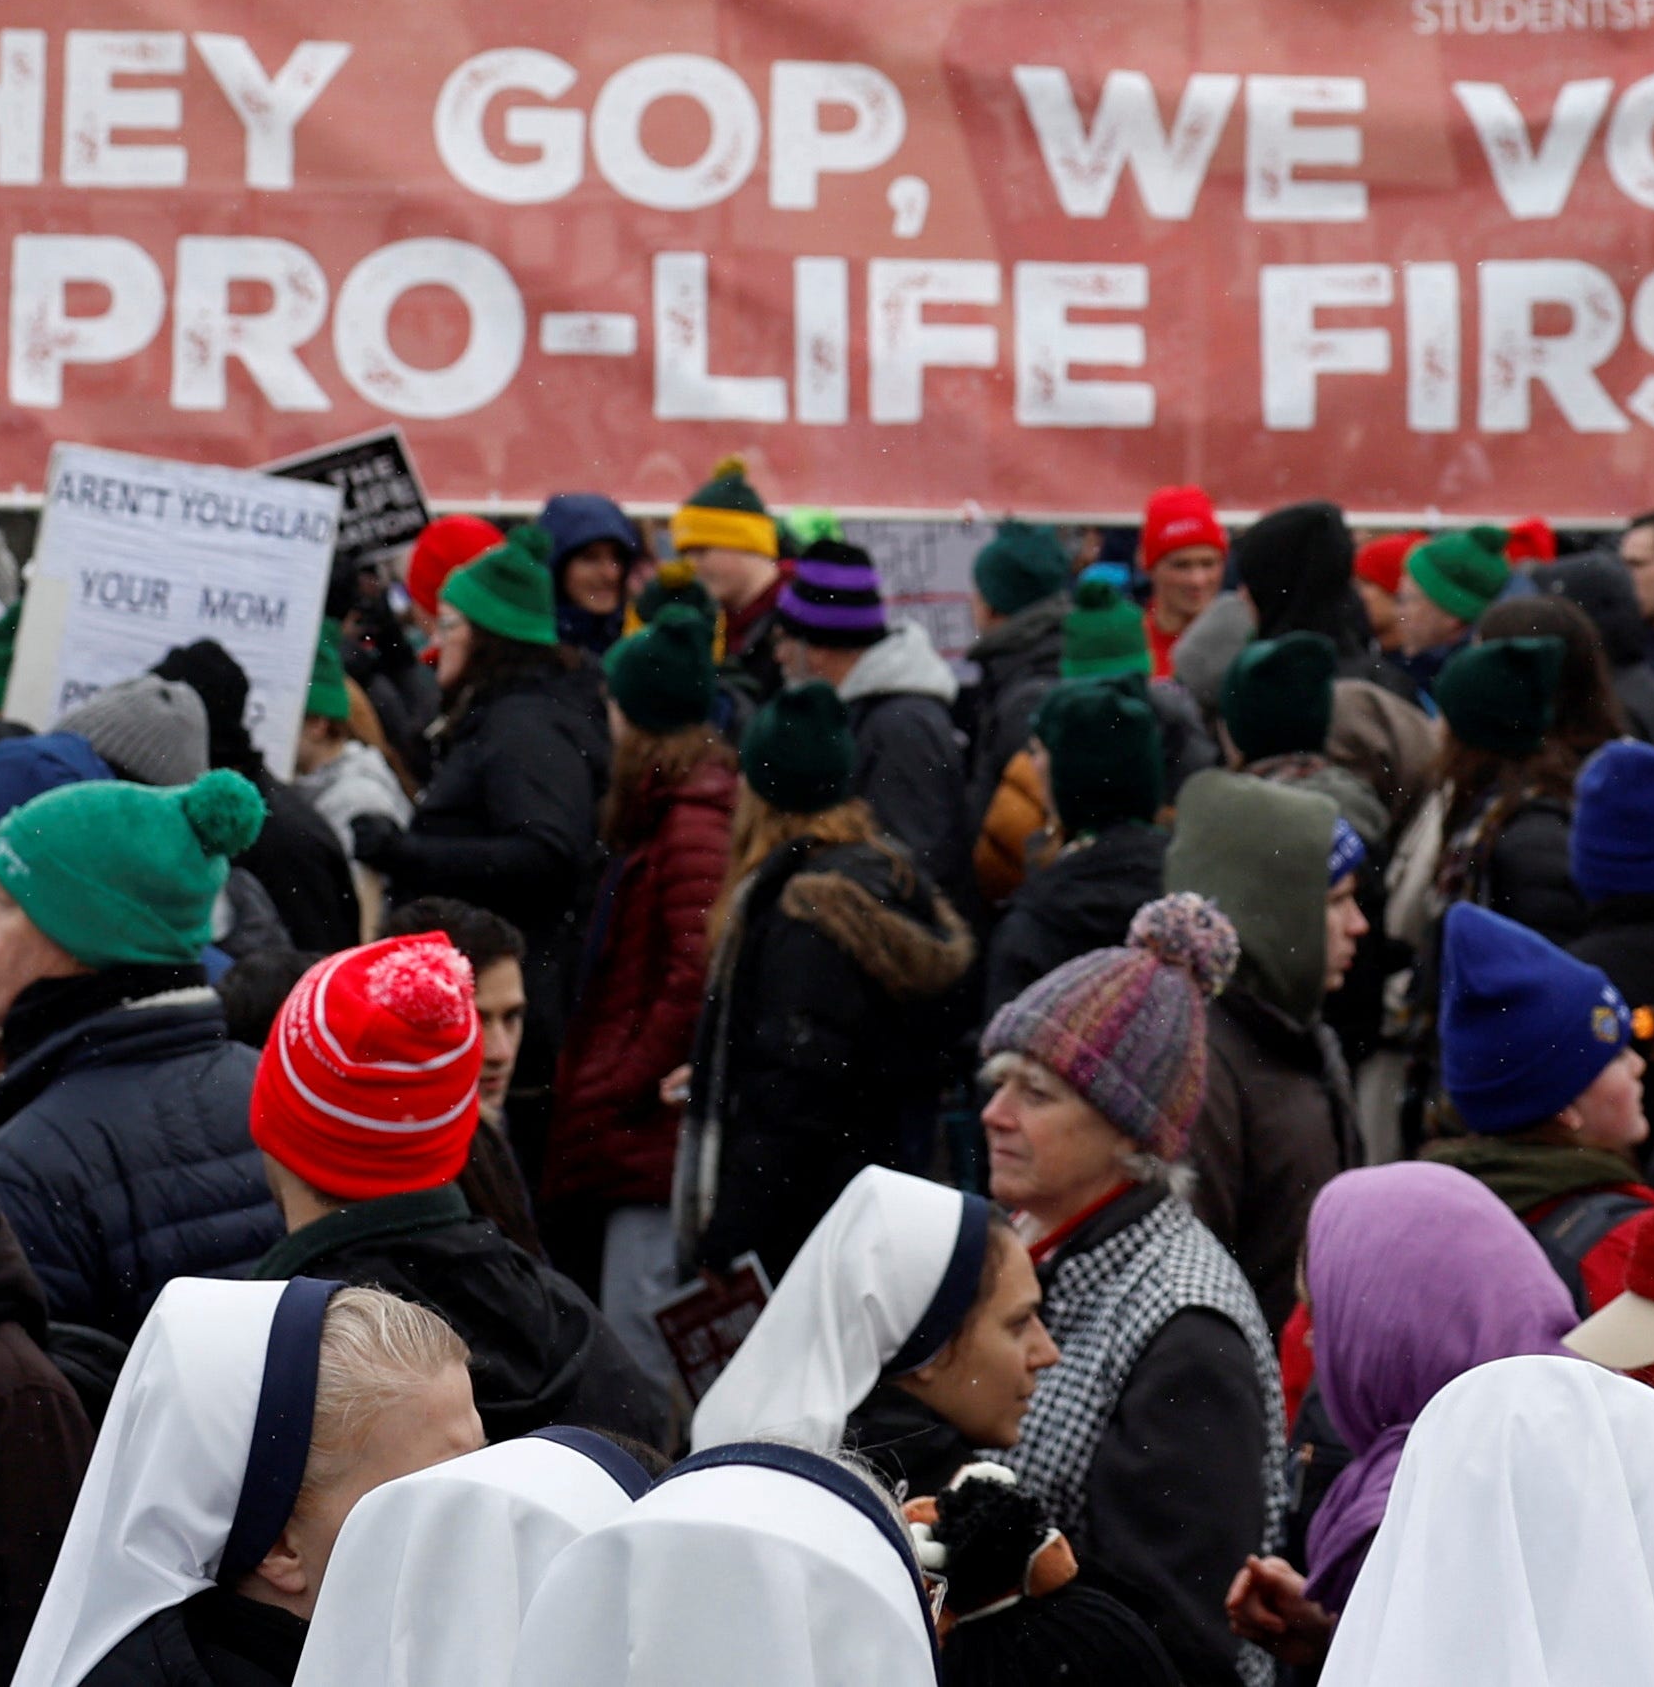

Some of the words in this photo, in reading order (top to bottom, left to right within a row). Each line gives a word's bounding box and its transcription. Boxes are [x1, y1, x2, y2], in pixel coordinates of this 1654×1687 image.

[433, 47, 930, 239] GOP,
[1012, 64, 1369, 223] WE
[7, 234, 1156, 430] PRO-LIFE
[57, 472, 171, 514] AREN'T
[179, 486, 247, 529] YOU
[250, 501, 330, 545] GLAD
[79, 569, 171, 613] YOUR
[199, 586, 287, 630] MOM
